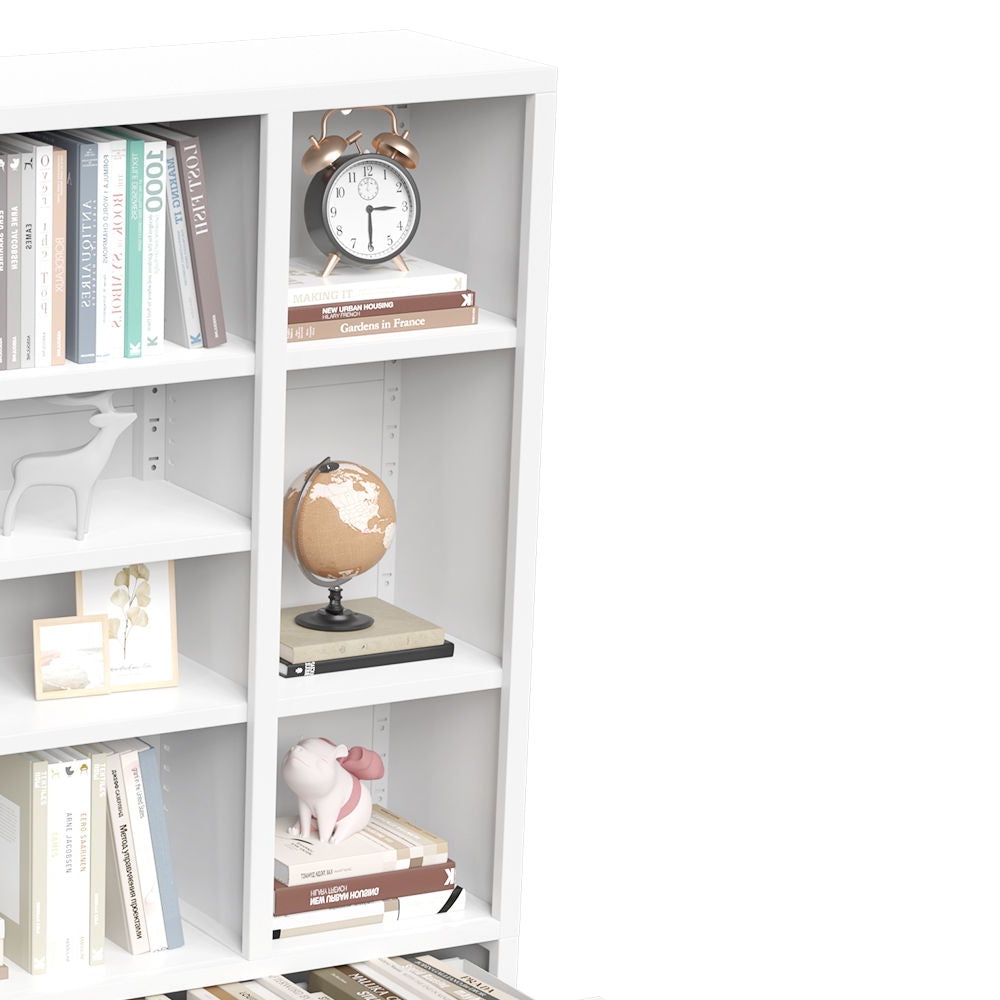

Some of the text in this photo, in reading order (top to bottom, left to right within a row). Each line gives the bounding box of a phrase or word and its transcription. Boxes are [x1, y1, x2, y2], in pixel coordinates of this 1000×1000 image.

[363, 166, 373, 177] 12
[383, 169, 387, 180] 1
[348, 172, 356, 183] 11
[336, 186, 345, 198] 10
[395, 182, 402, 193] 2
[330, 206, 337, 218] 9
[401, 201, 408, 212] 3
[336, 225, 343, 236] 8
[396, 220, 403, 231] 4
[351, 238, 357, 249] 7
[386, 234, 393, 246] 5
[322, 301, 394, 315] NEW URBAN HOUSING
[340, 318, 425, 334] Gardens in France
[119, 824, 142, 940] Метод управления проектами
[349, 972, 388, 997] MALLIKA
[460, 975, 496, 994] PRADA
